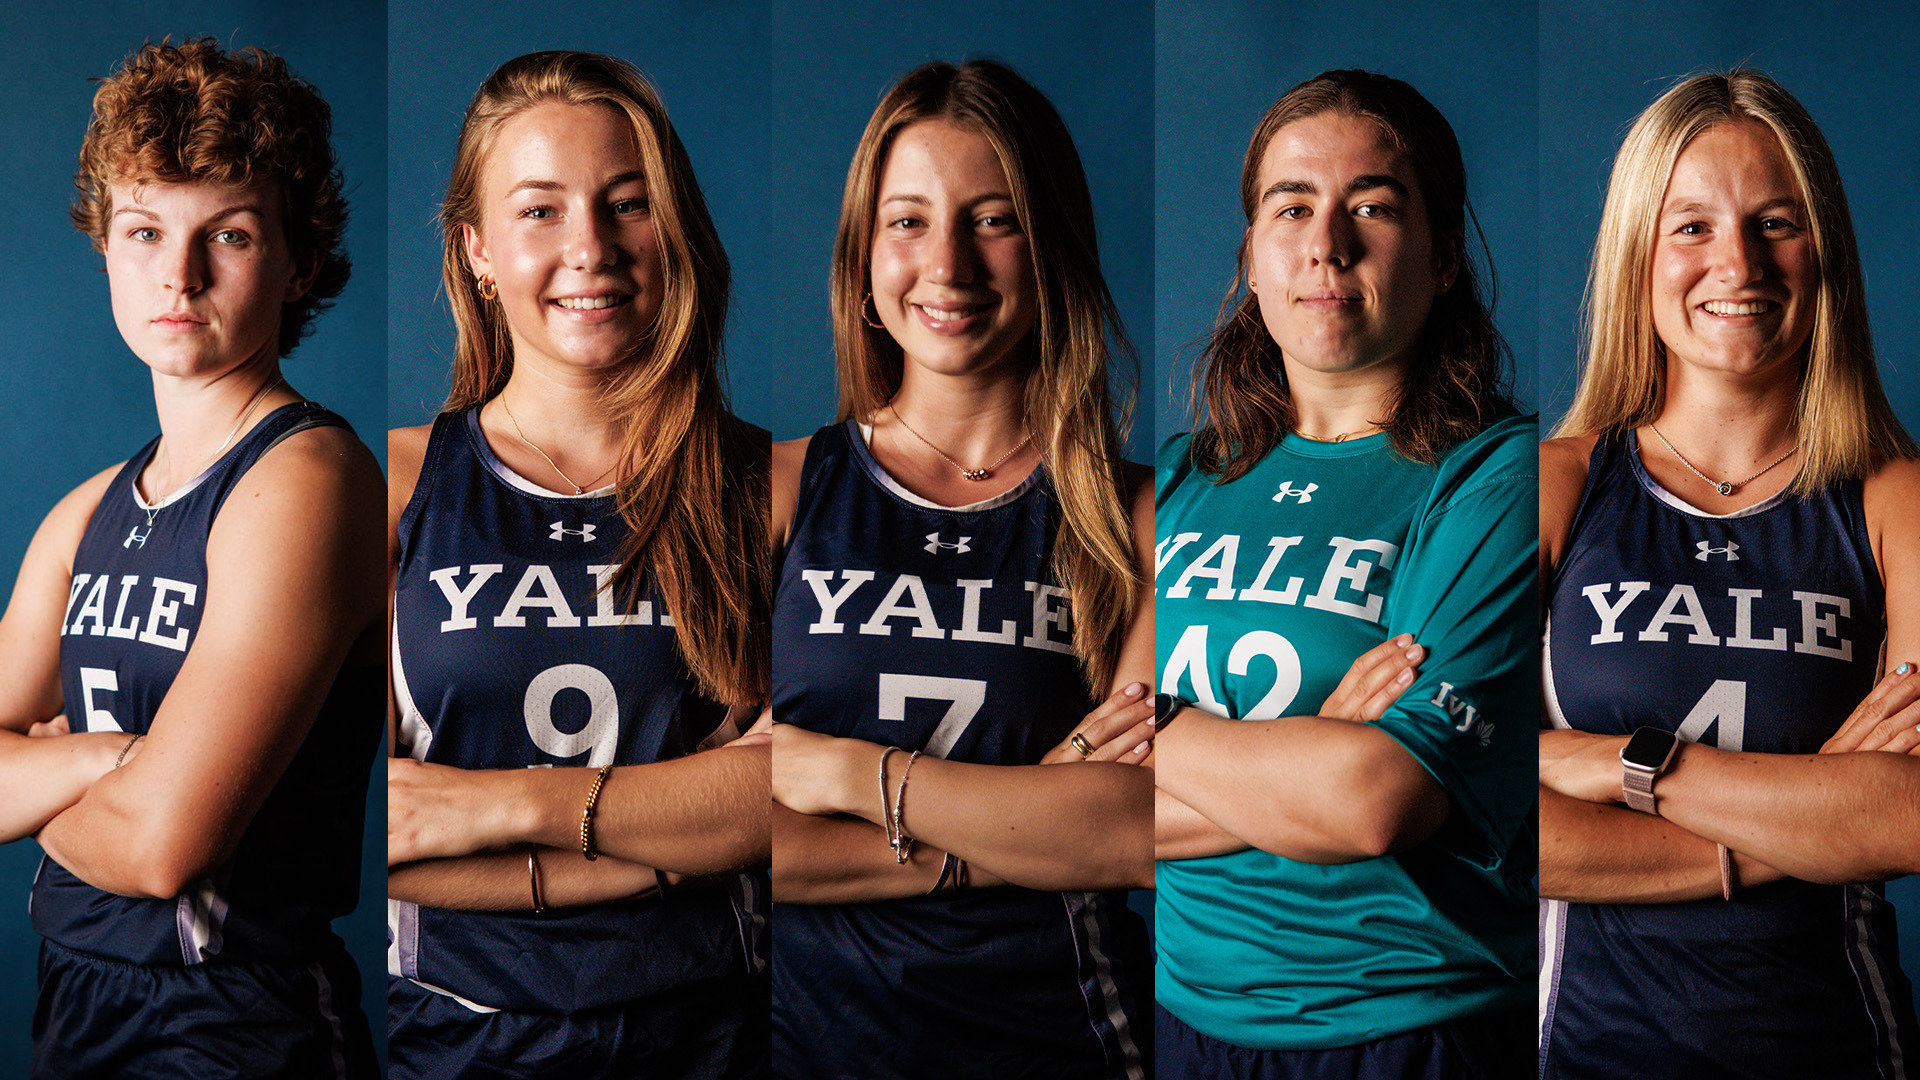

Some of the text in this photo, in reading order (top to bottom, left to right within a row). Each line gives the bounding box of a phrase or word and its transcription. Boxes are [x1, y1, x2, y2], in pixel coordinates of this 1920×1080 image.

[429, 564, 677, 633] YAL
[802, 569, 1077, 656] YALE
[1154, 532, 1399, 623] YALE
[1582, 581, 1852, 662] YALE
[524, 663, 619, 768] 9
[879, 673, 987, 759] 7
[1431, 681, 1480, 732] Ivy
